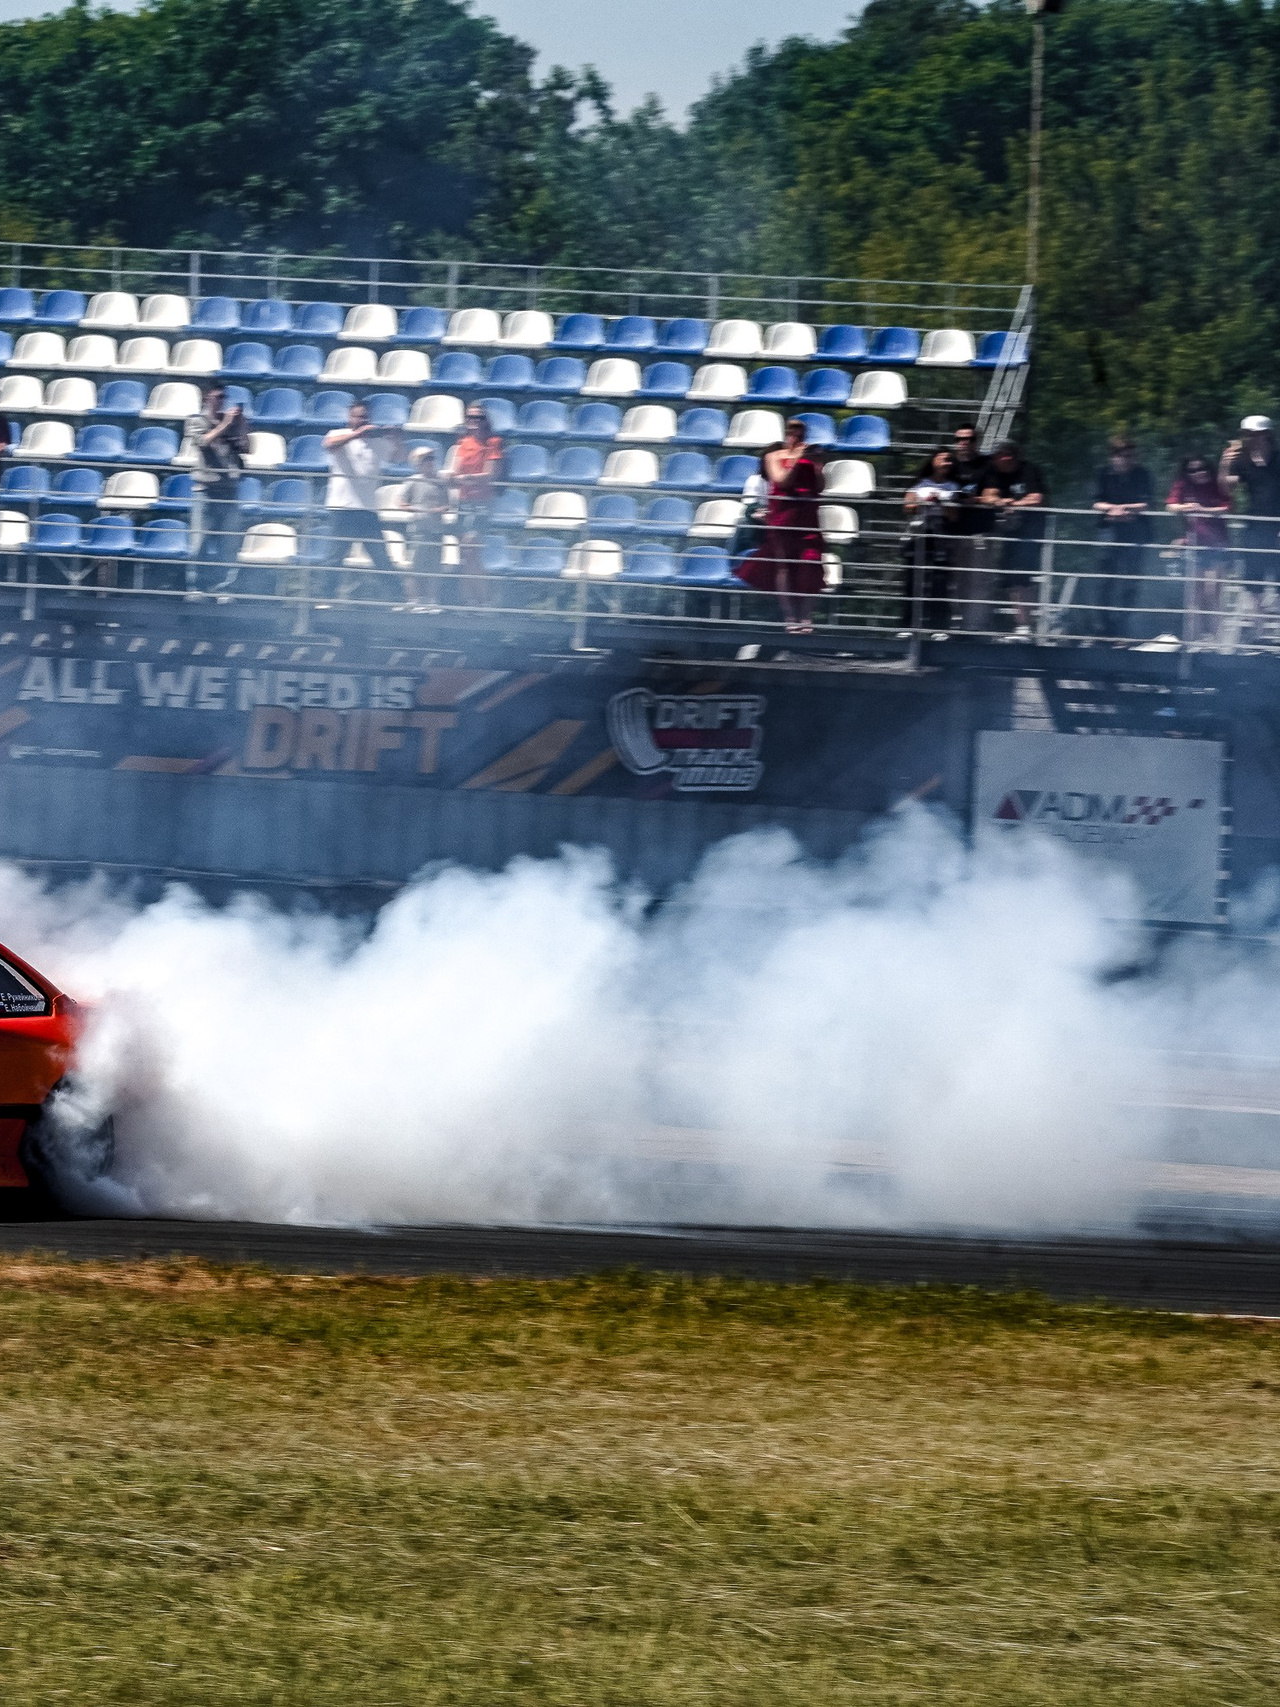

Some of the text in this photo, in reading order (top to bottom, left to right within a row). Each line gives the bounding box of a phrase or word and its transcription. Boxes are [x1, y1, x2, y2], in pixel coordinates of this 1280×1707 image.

[19, 656, 419, 712] ALL WE NEED IS
[242, 704, 459, 773] DRIFT
[657, 701, 762, 729] DRIFT
